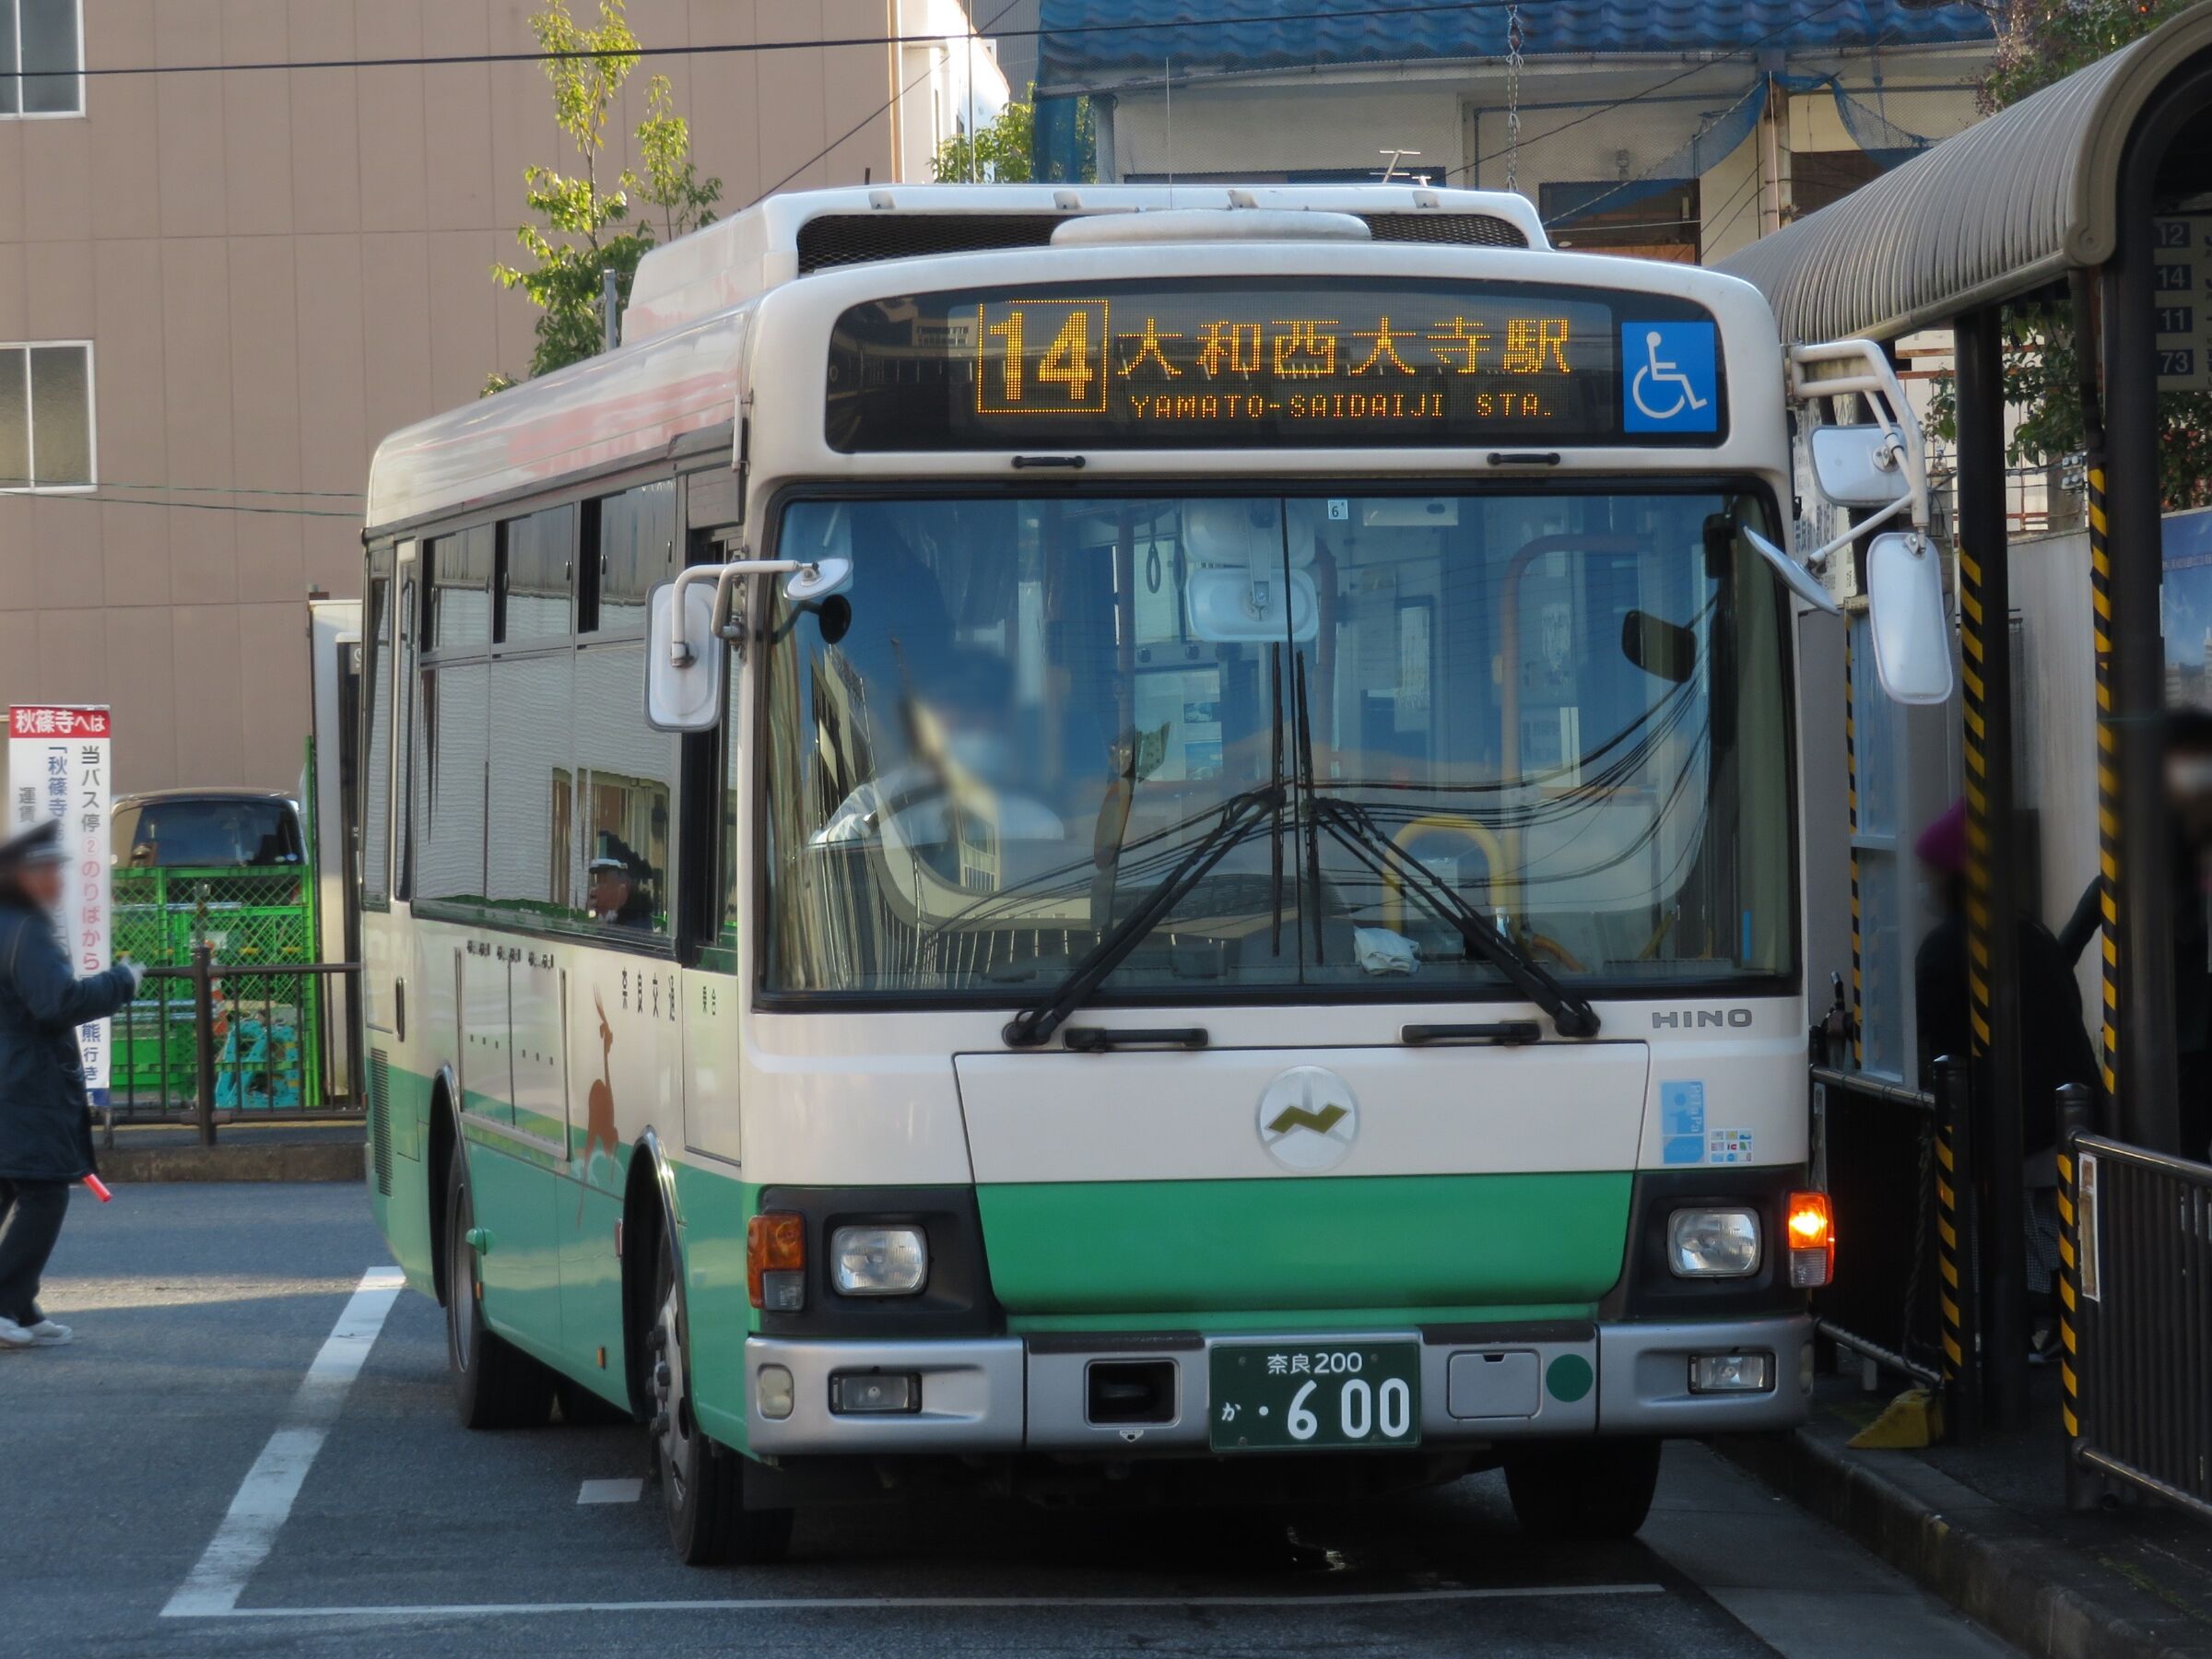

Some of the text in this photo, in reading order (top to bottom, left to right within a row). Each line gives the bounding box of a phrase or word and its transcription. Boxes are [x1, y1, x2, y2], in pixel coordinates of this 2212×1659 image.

[2159, 224, 2184, 246] 12
[2158, 265, 2185, 288] 14
[2160, 308, 2185, 331] 11
[988, 311, 1094, 401] 14
[1116, 316, 1571, 375] 大和西大寺駅
[2160, 351, 2189, 373] 73
[1130, 393, 1553, 418] YAMATO-SAIDAIJI STA.
[15, 709, 106, 735] 秋篠寺へは
[1653, 1008, 1753, 1030] HINO
[1220, 1401, 1242, 1422] か
